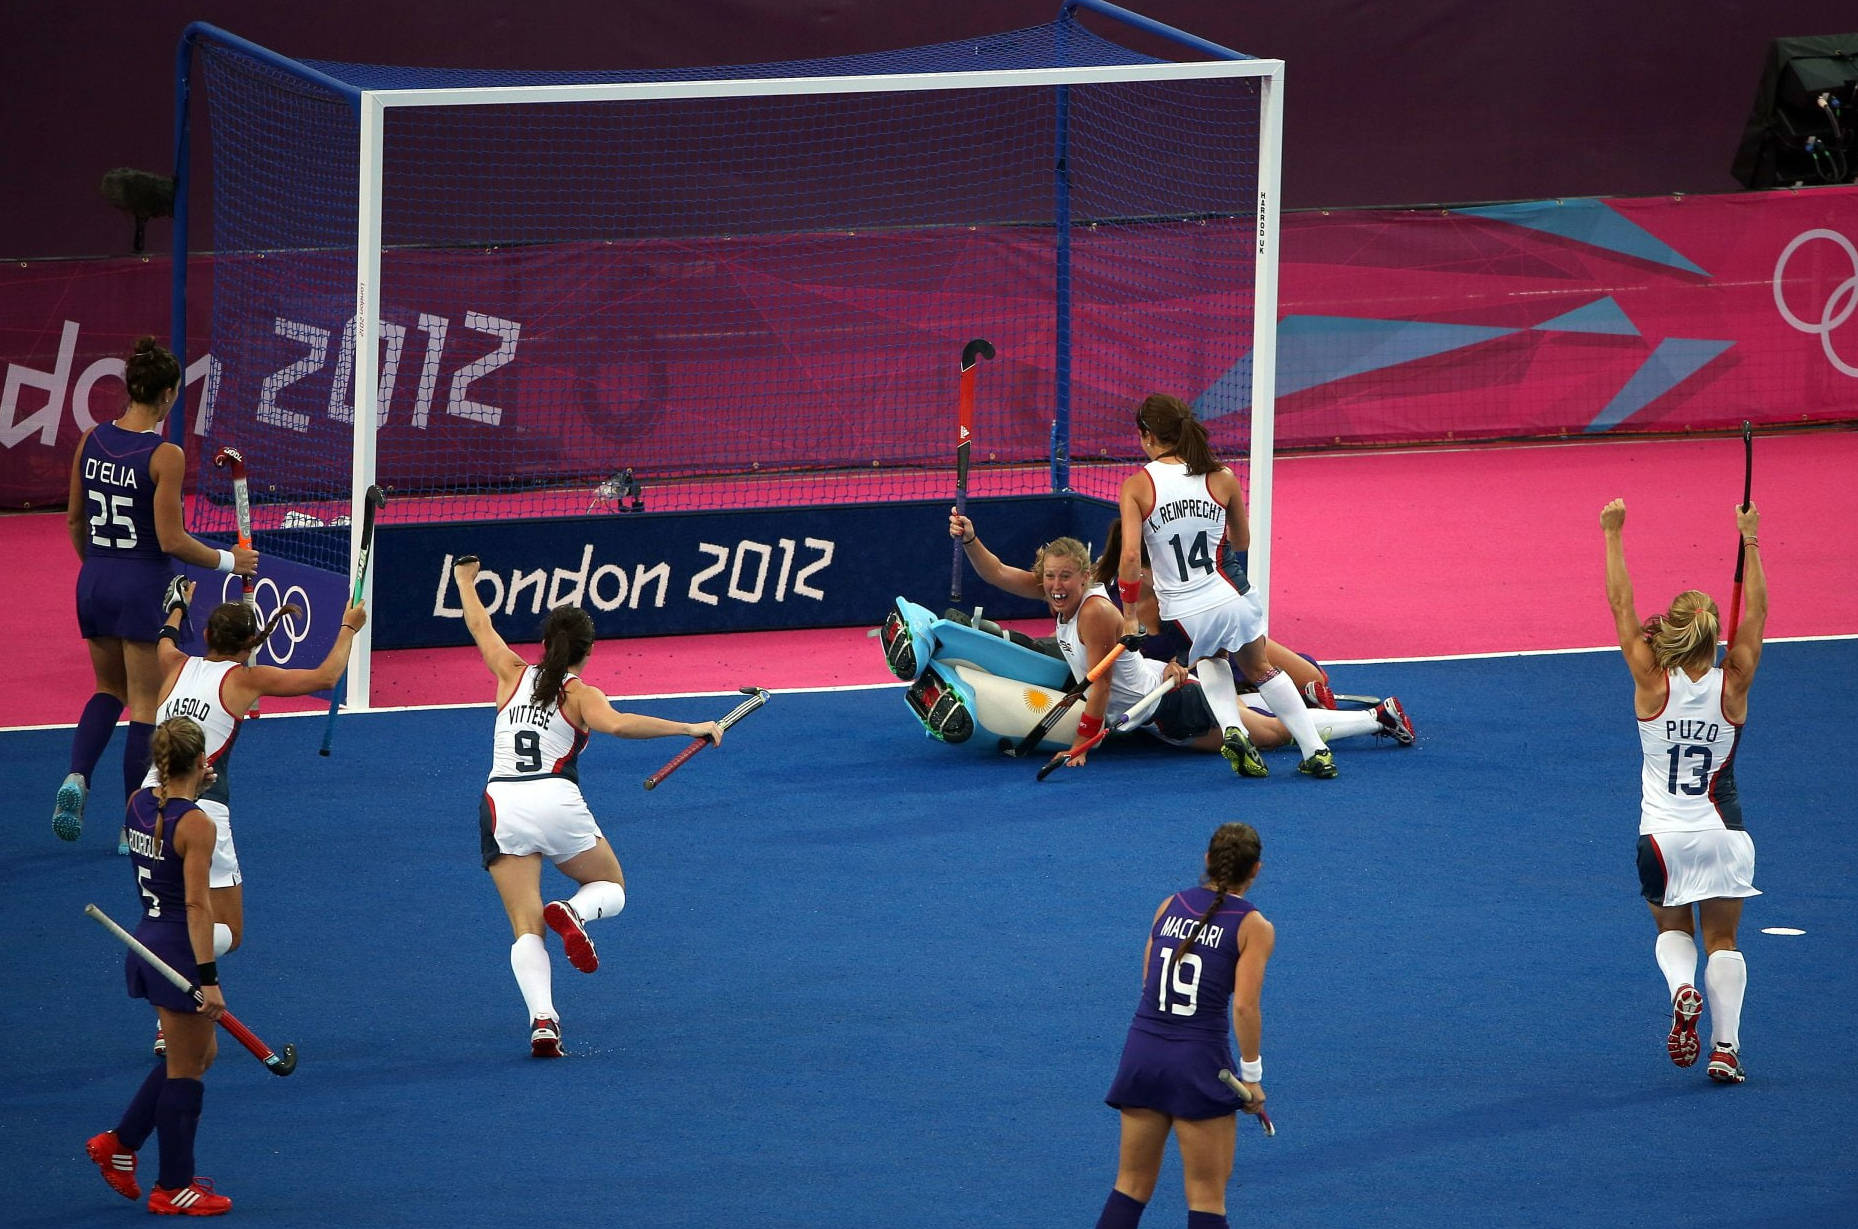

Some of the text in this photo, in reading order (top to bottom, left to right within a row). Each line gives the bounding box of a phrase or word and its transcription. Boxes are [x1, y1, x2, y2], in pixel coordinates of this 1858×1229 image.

[256, 310, 521, 434] 2012
[85, 458, 138, 489] D'ELIA
[88, 490, 137, 549] 25
[1147, 499, 1222, 533] K. REINPRECHT
[433, 544, 670, 618] London
[688, 538, 835, 605] 2012
[1168, 531, 1215, 582] 14
[165, 697, 211, 722] KASOLD
[509, 704, 553, 731] VITTESE
[1666, 719, 1719, 742] PUZO
[514, 730, 543, 773] 9
[1666, 745, 1713, 796] 13
[138, 865, 161, 918] 5
[1158, 947, 1203, 1017] 19
